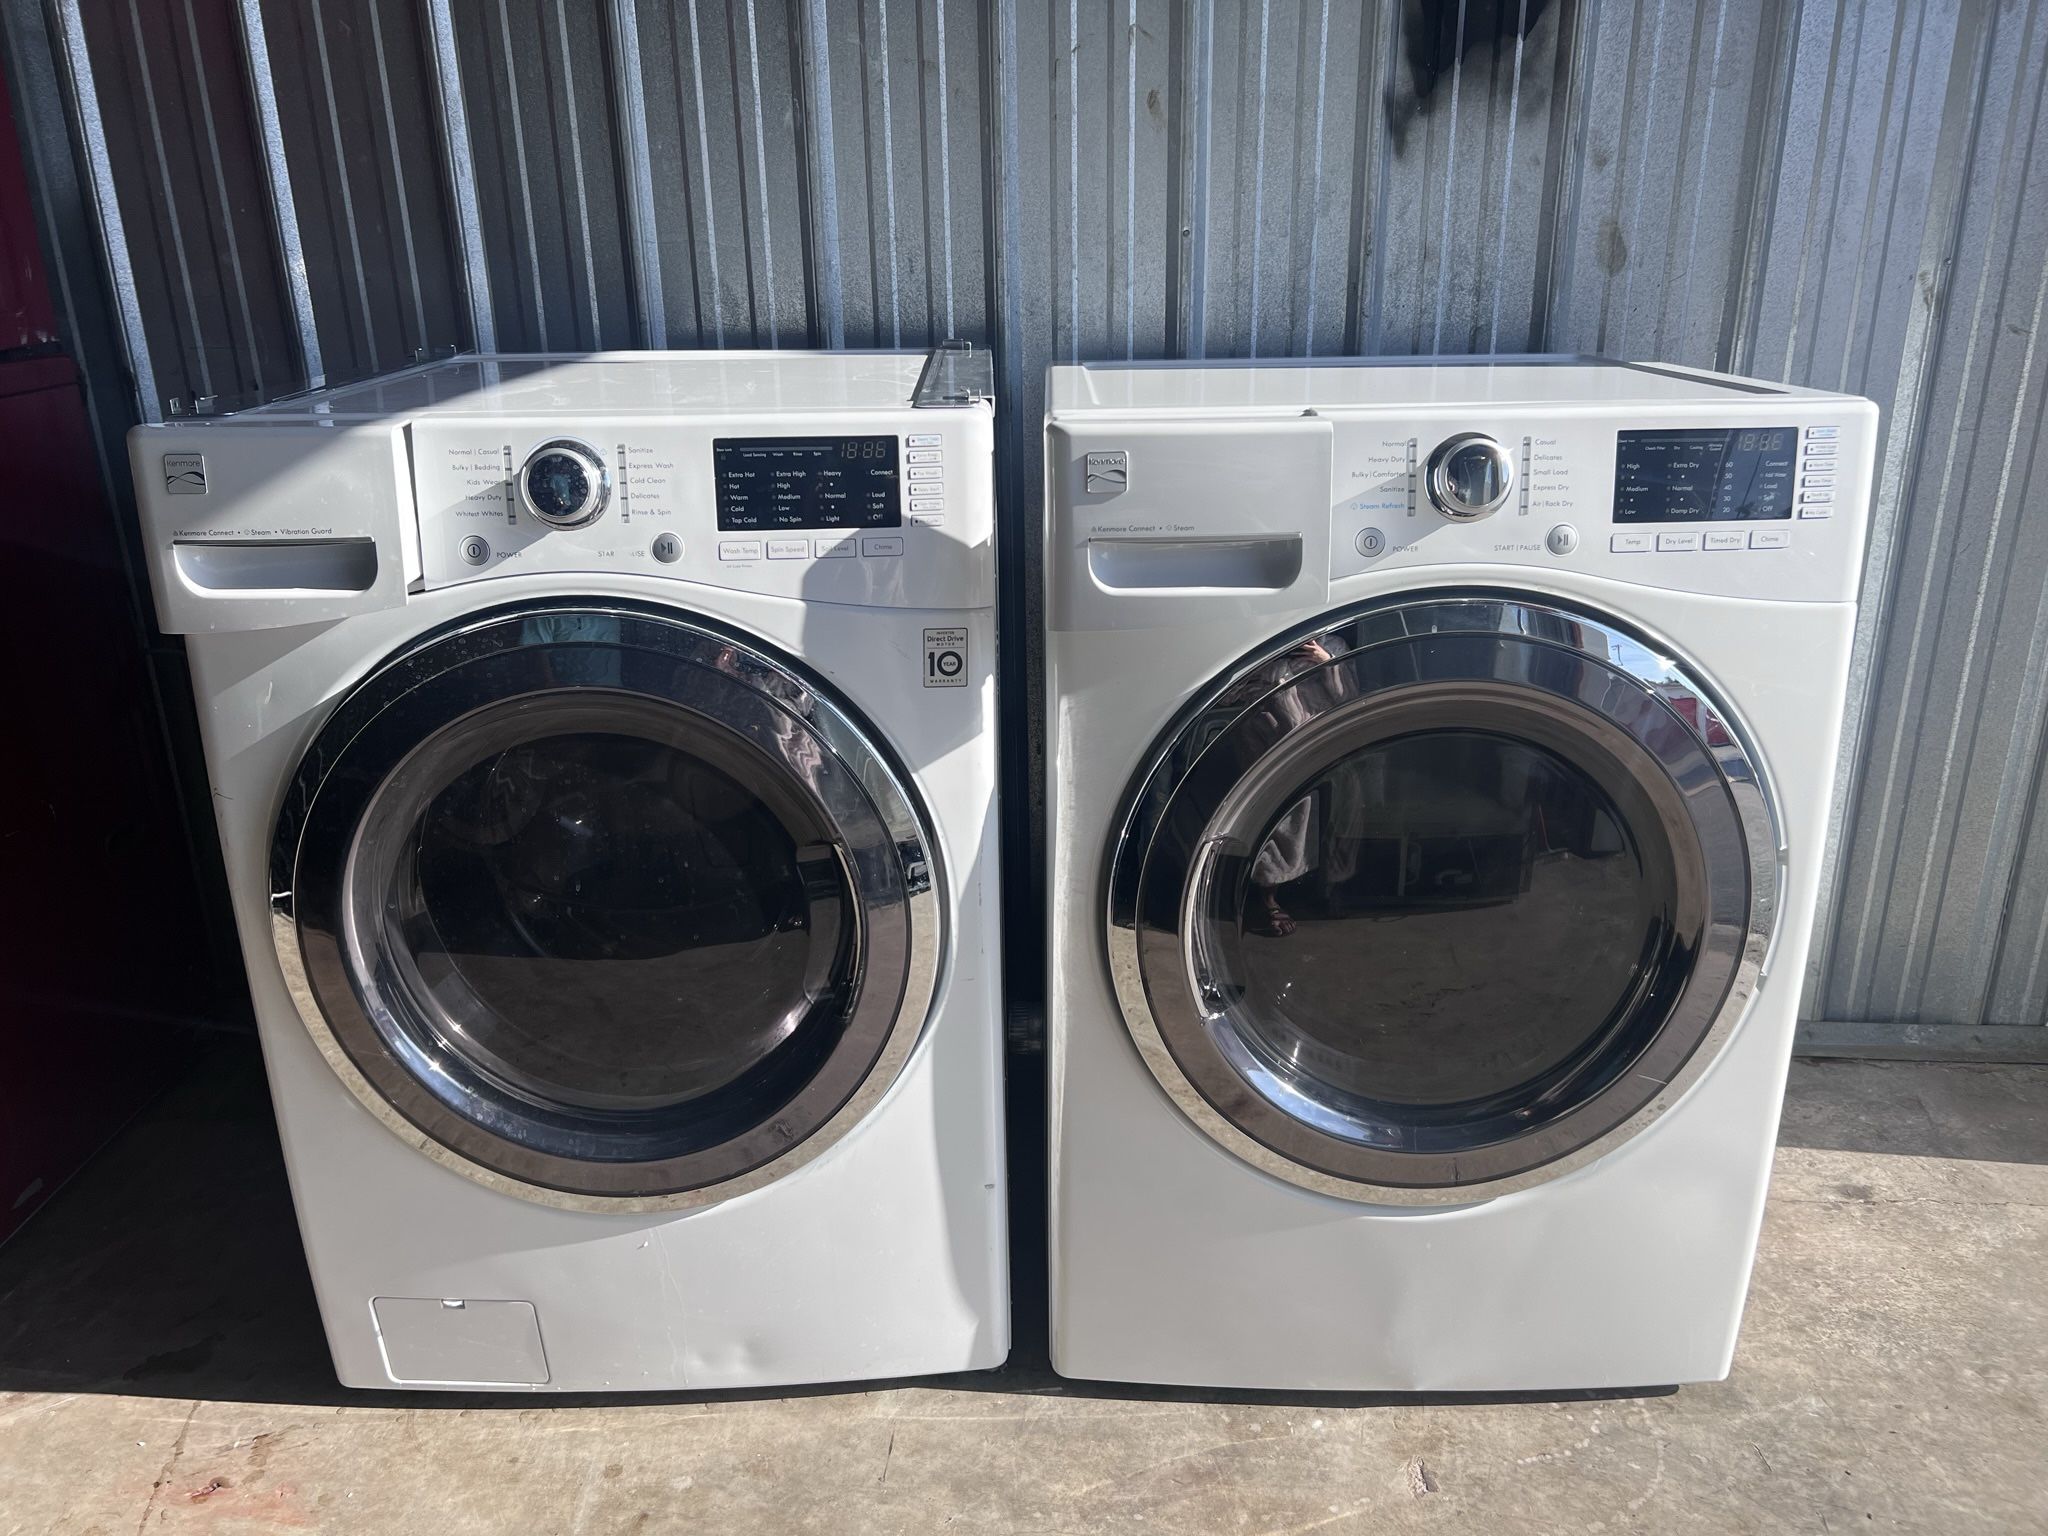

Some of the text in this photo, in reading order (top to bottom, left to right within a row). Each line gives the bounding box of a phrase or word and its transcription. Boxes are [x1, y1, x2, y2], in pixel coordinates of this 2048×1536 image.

[167, 460, 200, 468] Kenmore
[452, 464, 500, 472] Bulky Bedding
[629, 463, 653, 471] Express
[1558, 484, 1570, 492] Dry
[658, 508, 672, 517] Spin
[280, 528, 309, 536] Vibration
[1625, 538, 1641, 546] Temp
[1730, 537, 1741, 545] Dry
[742, 547, 758, 556] Temp
[771, 546, 805, 554] Spin Speed
[928, 650, 963, 677] 10
